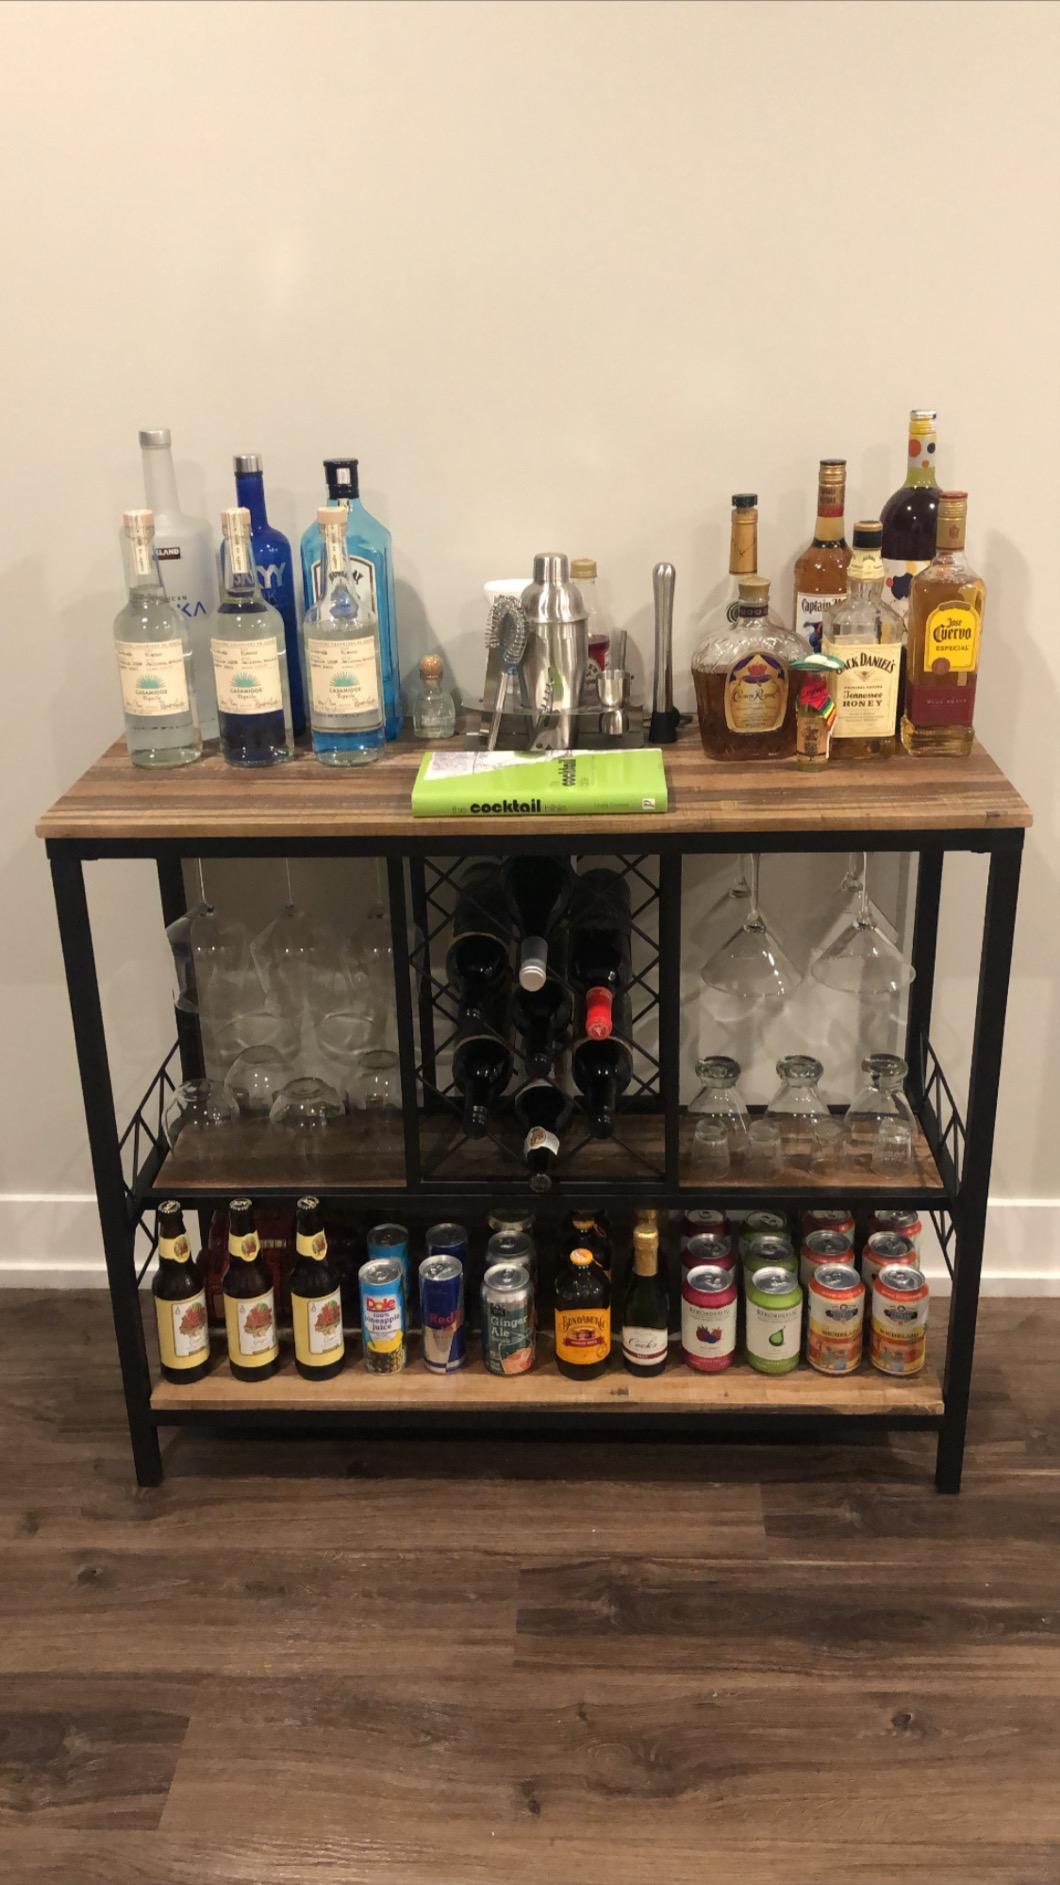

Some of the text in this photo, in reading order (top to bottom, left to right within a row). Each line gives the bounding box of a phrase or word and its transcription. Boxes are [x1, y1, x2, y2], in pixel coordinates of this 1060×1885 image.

[933, 624, 972, 643] Cuervo
[935, 644, 969, 652] ESPECIAL
[859, 652, 896, 674] DANIEL'S
[843, 689, 883, 699] Tennessee
[842, 700, 883, 708] HONEY
[469, 799, 541, 814] cocktail
[366, 1297, 396, 1310] Dole
[490, 1315, 528, 1328] Ginger
[491, 1327, 510, 1338] Ale
